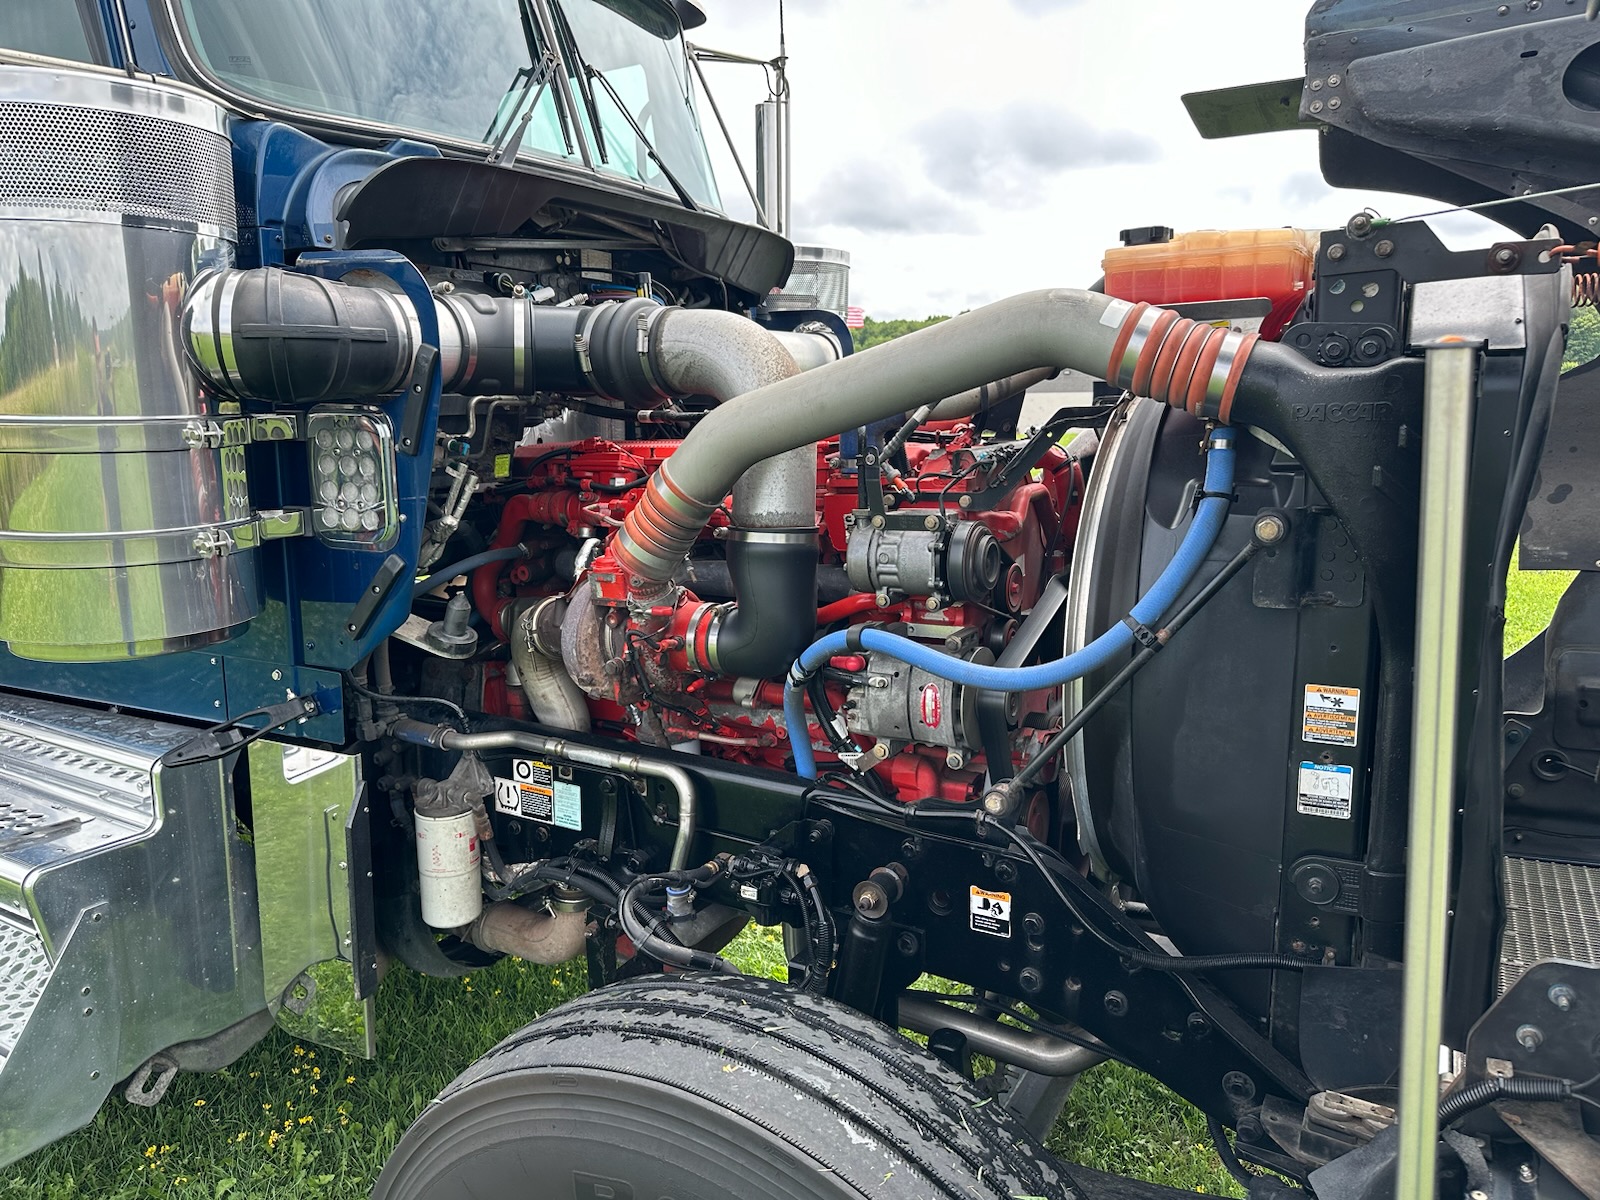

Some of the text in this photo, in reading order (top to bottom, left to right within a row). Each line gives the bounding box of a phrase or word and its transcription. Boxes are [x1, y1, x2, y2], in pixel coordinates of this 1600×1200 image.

[1290, 401, 1393, 423] PACCAR
[1323, 687, 1349, 695] WARNING
[1313, 712, 1355, 722] AVERTISSEMENT
[1315, 728, 1352, 736] ADVERTENCIA
[1313, 764, 1338, 772] NOTICE
[980, 891, 1005, 900] WARNING
